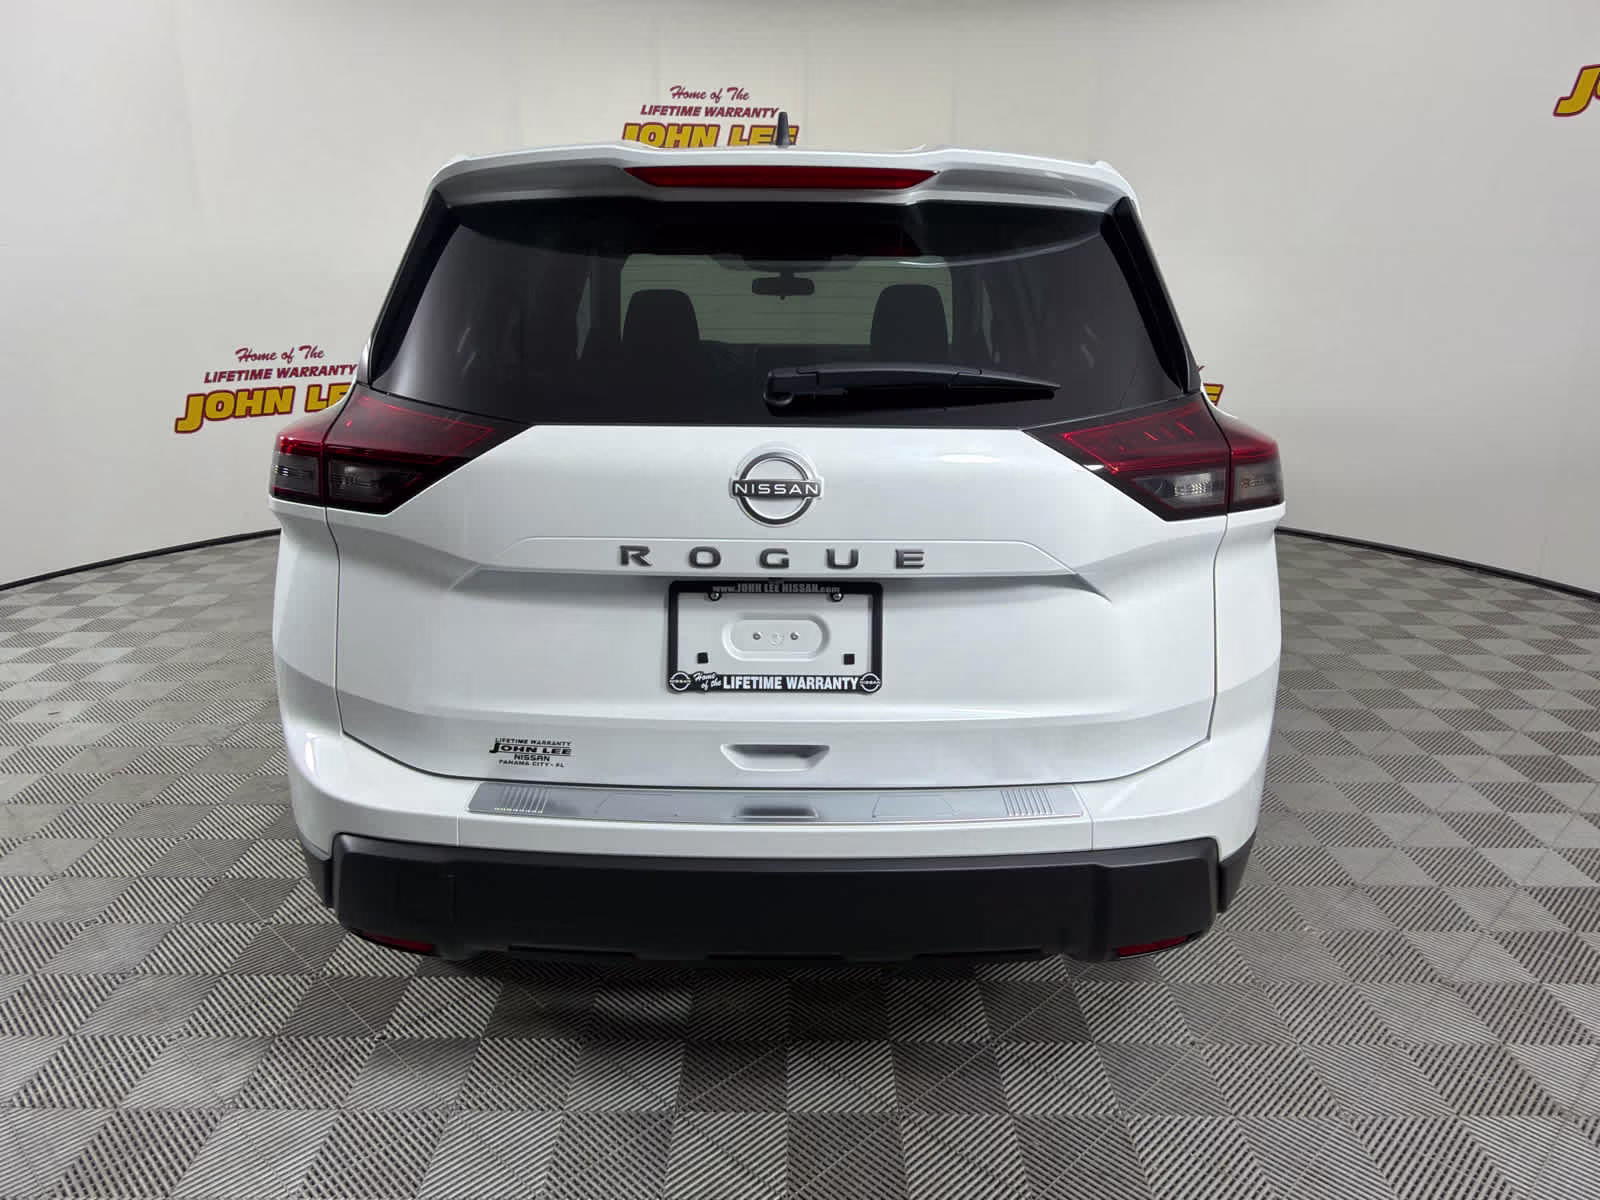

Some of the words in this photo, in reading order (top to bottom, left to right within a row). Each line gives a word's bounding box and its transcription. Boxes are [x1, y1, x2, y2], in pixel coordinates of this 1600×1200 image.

[670, 85, 706, 100] Home
[710, 88, 722, 103] of
[727, 86, 750, 101] The
[640, 104, 701, 117] LIFETIME
[704, 106, 780, 118] WARRANTY
[622, 122, 720, 149] JOHN
[235, 346, 277, 363] Home
[281, 347, 294, 363] of
[299, 345, 325, 360] The
[204, 368, 273, 384] LIFETIME
[276, 364, 357, 380] WARRANTY
[174, 386, 296, 433] JOHN
[304, 383, 352, 412] LE
[734, 482, 820, 496] NISSAN
[619, 544, 926, 570] ROGUE
[764, 584, 780, 593] LEE
[723, 676, 783, 690] LIFETIME
[786, 677, 860, 691] WARRANTY
[489, 743, 538, 753] JOHN
[542, 747, 572, 756] LEE
[514, 753, 551, 761] NISSAN
